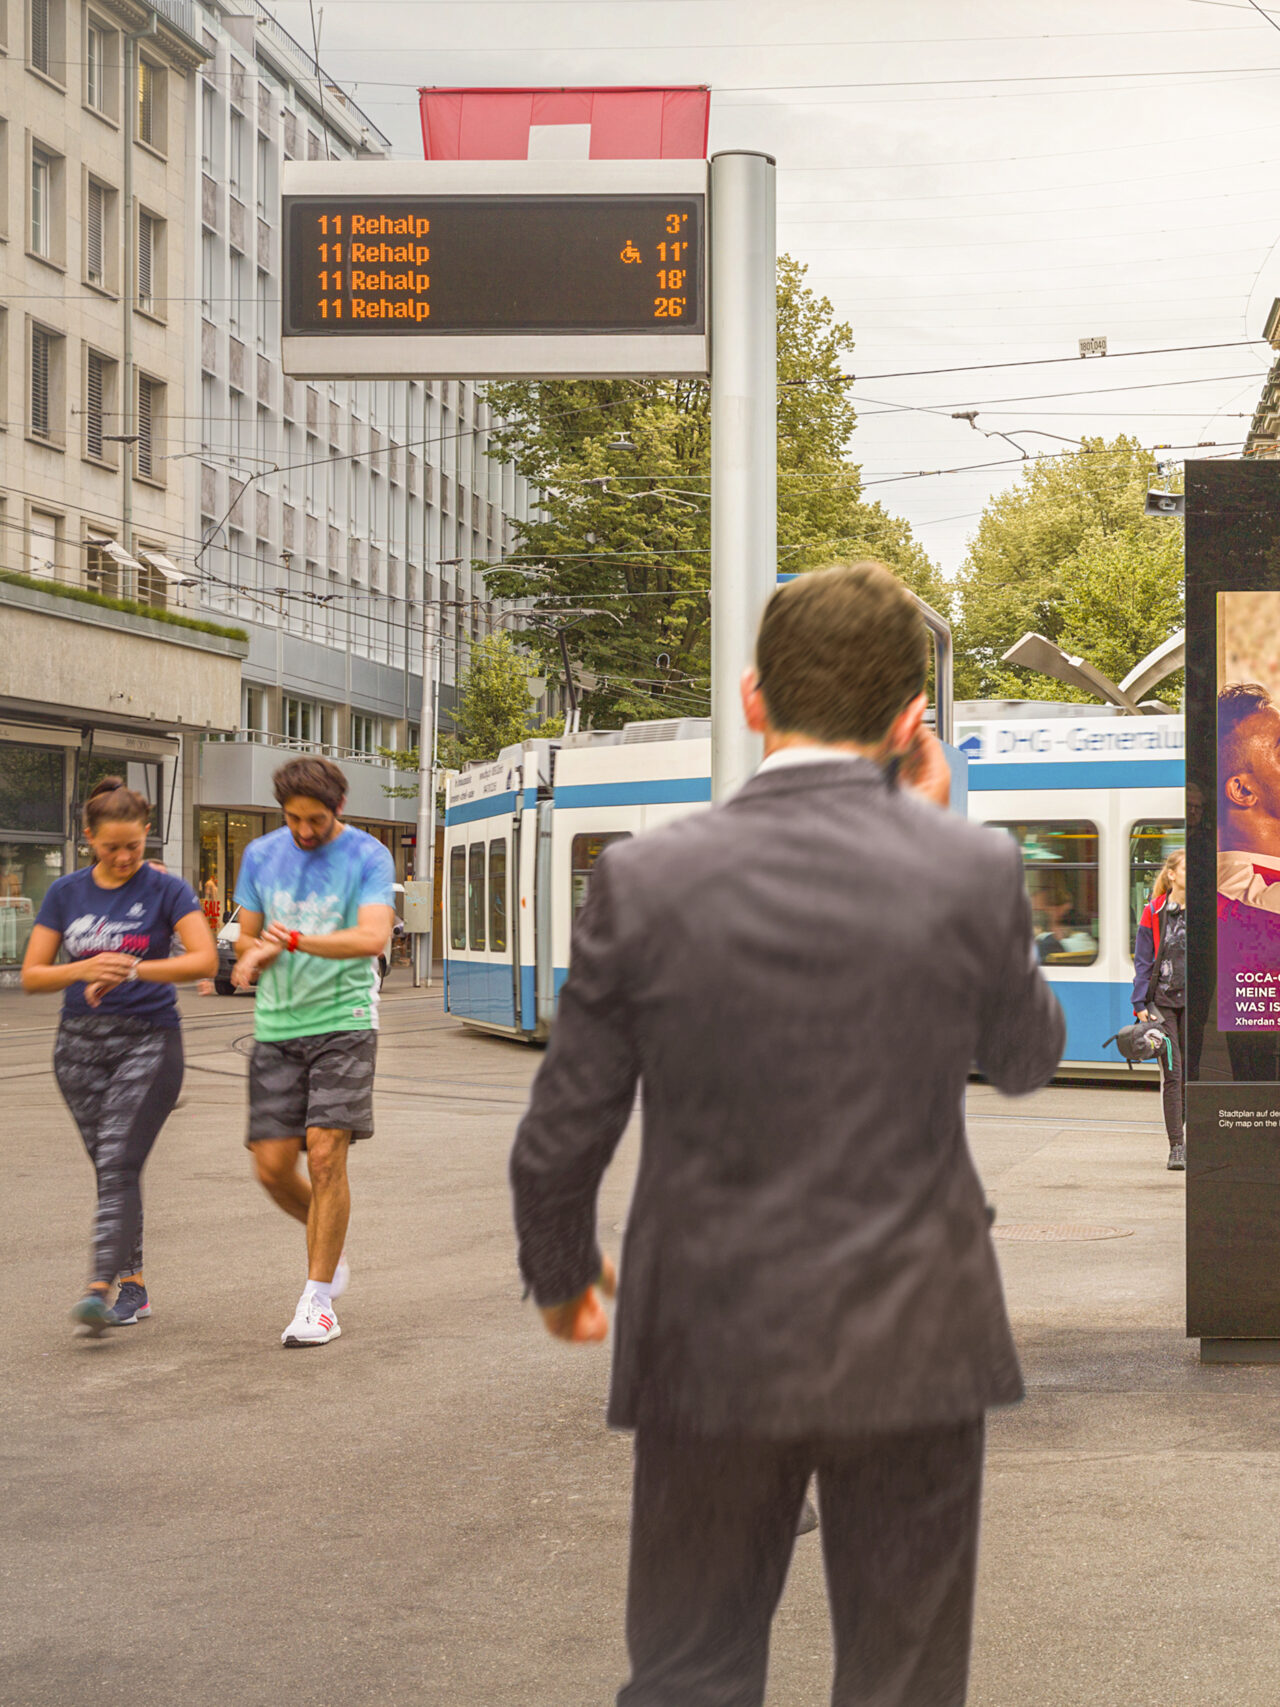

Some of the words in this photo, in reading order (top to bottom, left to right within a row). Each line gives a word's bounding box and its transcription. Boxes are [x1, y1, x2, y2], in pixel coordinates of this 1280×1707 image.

[317, 215, 342, 235] 11
[351, 215, 430, 238] Rehalp
[665, 213, 689, 234] 3'
[317, 243, 342, 263] 11
[351, 243, 430, 266] Rehalp
[656, 241, 689, 262] 11'
[317, 271, 342, 291] 11
[351, 271, 430, 294] Rehalp
[656, 269, 687, 290] 18'
[317, 299, 342, 319] 11
[351, 299, 430, 322] Rehalp
[654, 297, 687, 318] 26'
[204, 900, 220, 917] SALE
[1235, 987, 1277, 998] MEINE
[1235, 1002, 1265, 1012] WAS
[1235, 1017, 1275, 1026] Xherdan
[1218, 1109, 1254, 1119] Stadtplan
[1256, 1109, 1268, 1118] auf
[1218, 1120, 1234, 1129] City
[1235, 1121, 1252, 1129] map
[1265, 1120, 1277, 1128] the
